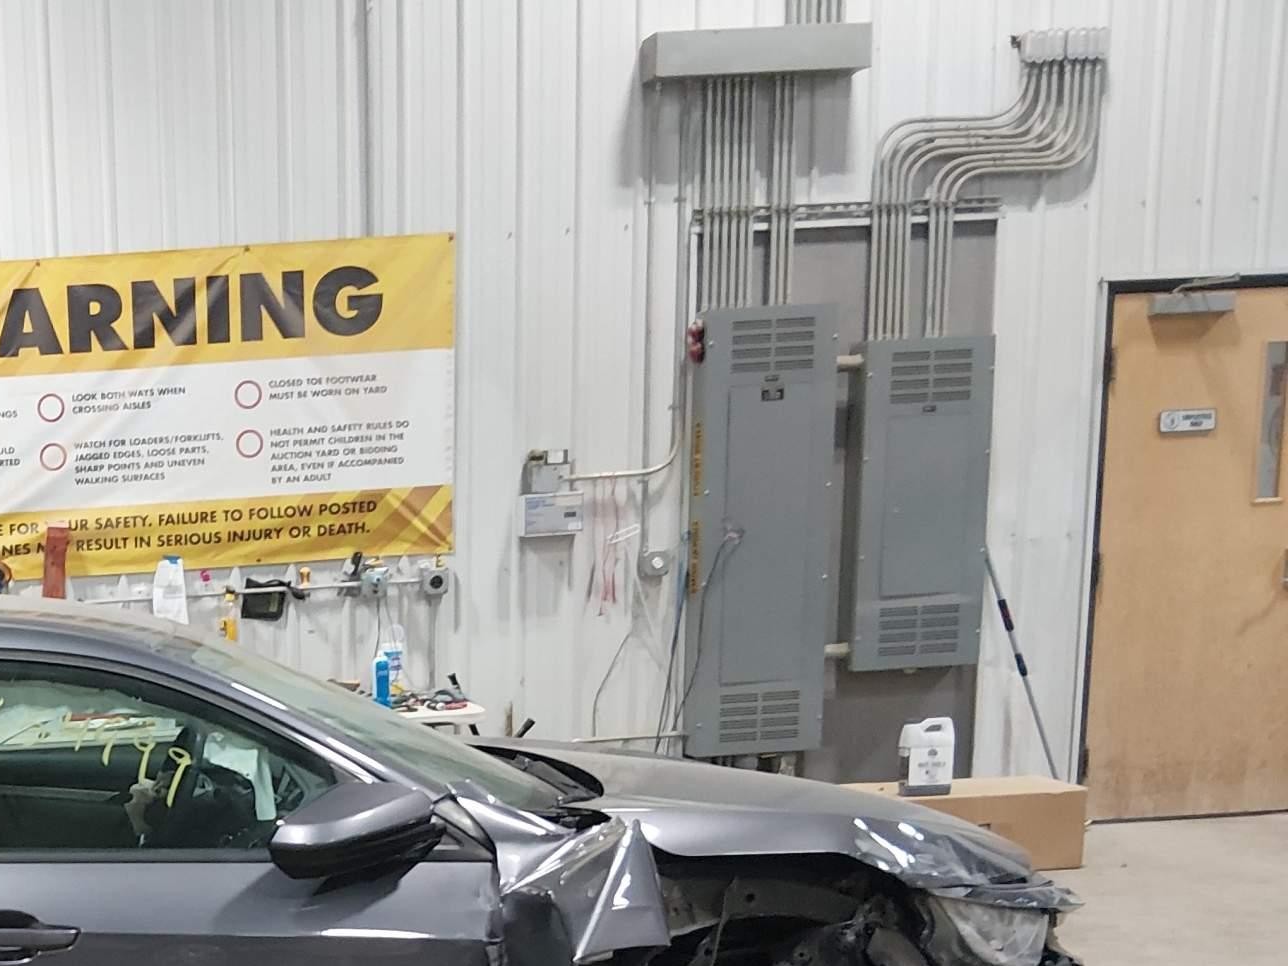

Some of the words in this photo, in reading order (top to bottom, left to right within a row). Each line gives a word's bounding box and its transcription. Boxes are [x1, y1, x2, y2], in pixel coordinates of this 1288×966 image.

[268, 378, 303, 389] CLOSED
[306, 377, 323, 386] TOE
[326, 374, 377, 385] FOOTWEAR
[72, 393, 97, 402] LOOK
[100, 391, 125, 400] BOTH
[127, 388, 155, 398] WAYS
[157, 386, 186, 396] WHEN
[269, 391, 294, 401] MUST
[297, 390, 308, 399] BE
[311, 388, 342, 398] WORN
[344, 387, 360, 396] ON
[363, 385, 388, 395] YARD
[72, 403, 120, 414] CROSSING
[123, 401, 152, 410] AISLES
[270, 427, 304, 436] HEALTH
[306, 425, 328, 434] AND
[331, 423, 363, 433] SAFETY
[366, 421, 393, 430] RULES
[395, 420, 410, 428] DO
[74, 440, 106, 450] WATCH
[109, 438, 126, 447] FOR
[270, 440, 290, 449] NOT
[293, 437, 325, 447] PERMIT
[328, 435, 372, 445] CHILDREN
[375, 434, 386, 442] IN
[389, 432, 404, 440] THE
[75, 453, 110, 462] JAGGED
[147, 448, 176, 457] LOOSE
[270, 451, 312, 461] AUCTION
[315, 449, 340, 458] YARD
[342, 447, 356, 456] OR
[75, 465, 104, 474] SHARP
[107, 462, 141, 472] POINTS
[144, 460, 164, 470] AND
[167, 458, 205, 468] UNEVEN
[300, 462, 324, 471] EVEN
[327, 460, 335, 469] IF
[338, 457, 404, 468] ACCOMPANIED
[75, 475, 119, 486] WALKING
[121, 472, 166, 483] SURFACES
[271, 475, 282, 484] BY
[286, 474, 300, 483] AN
[303, 473, 332, 482] ADULT
[9, 522, 39, 536] FOR
[158, 510, 217, 526] FAILURE
[224, 508, 243, 522] TO
[249, 504, 314, 520] FOLLOW
[319, 500, 377, 516] POSTED
[76, 537, 128, 551] RESULT
[134, 535, 151, 548] IN
[157, 531, 221, 547] SERIOUS
[227, 527, 283, 543] INJURY
[288, 524, 312, 538] OR
[317, 522, 370, 537] DEATH.
